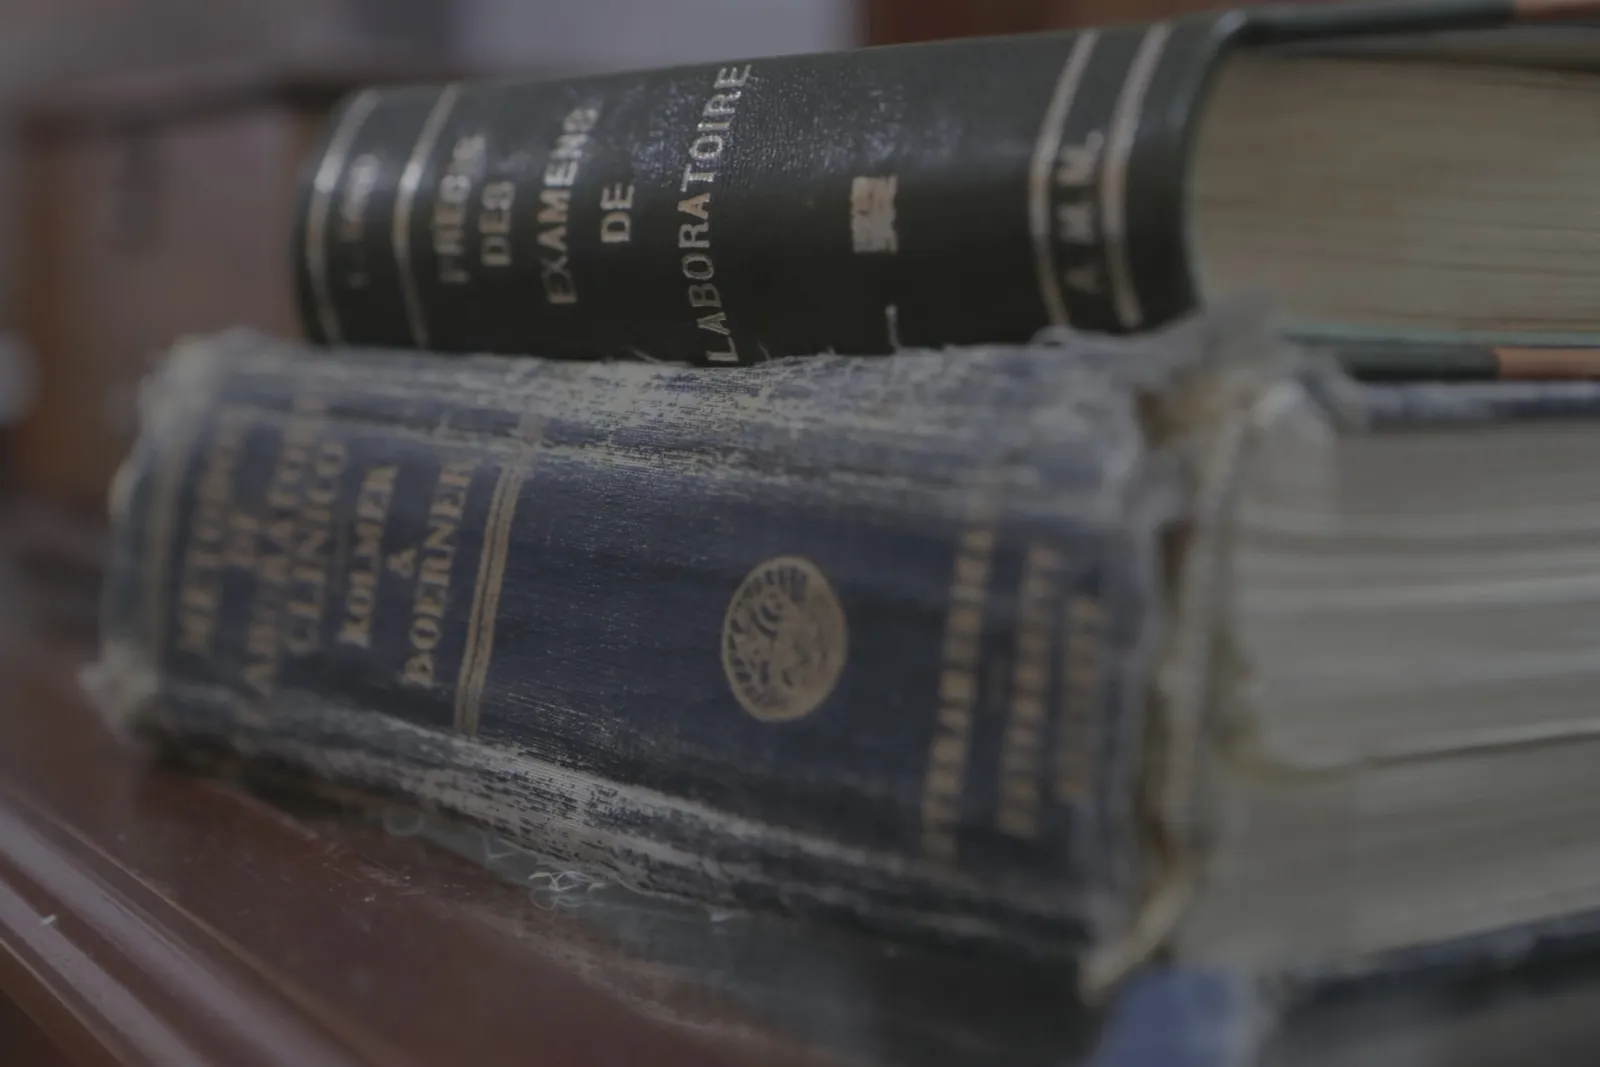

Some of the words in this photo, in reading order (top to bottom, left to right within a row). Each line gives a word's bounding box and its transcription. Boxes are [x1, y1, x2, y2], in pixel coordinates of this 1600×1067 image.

[536, 105, 600, 304] EXAMENS
[600, 182, 635, 243] DE
[678, 63, 753, 363] LABORATOIRE
[338, 465, 399, 649] KOLMER
[385, 547, 417, 579] &
[400, 461, 471, 688] BOERNER
